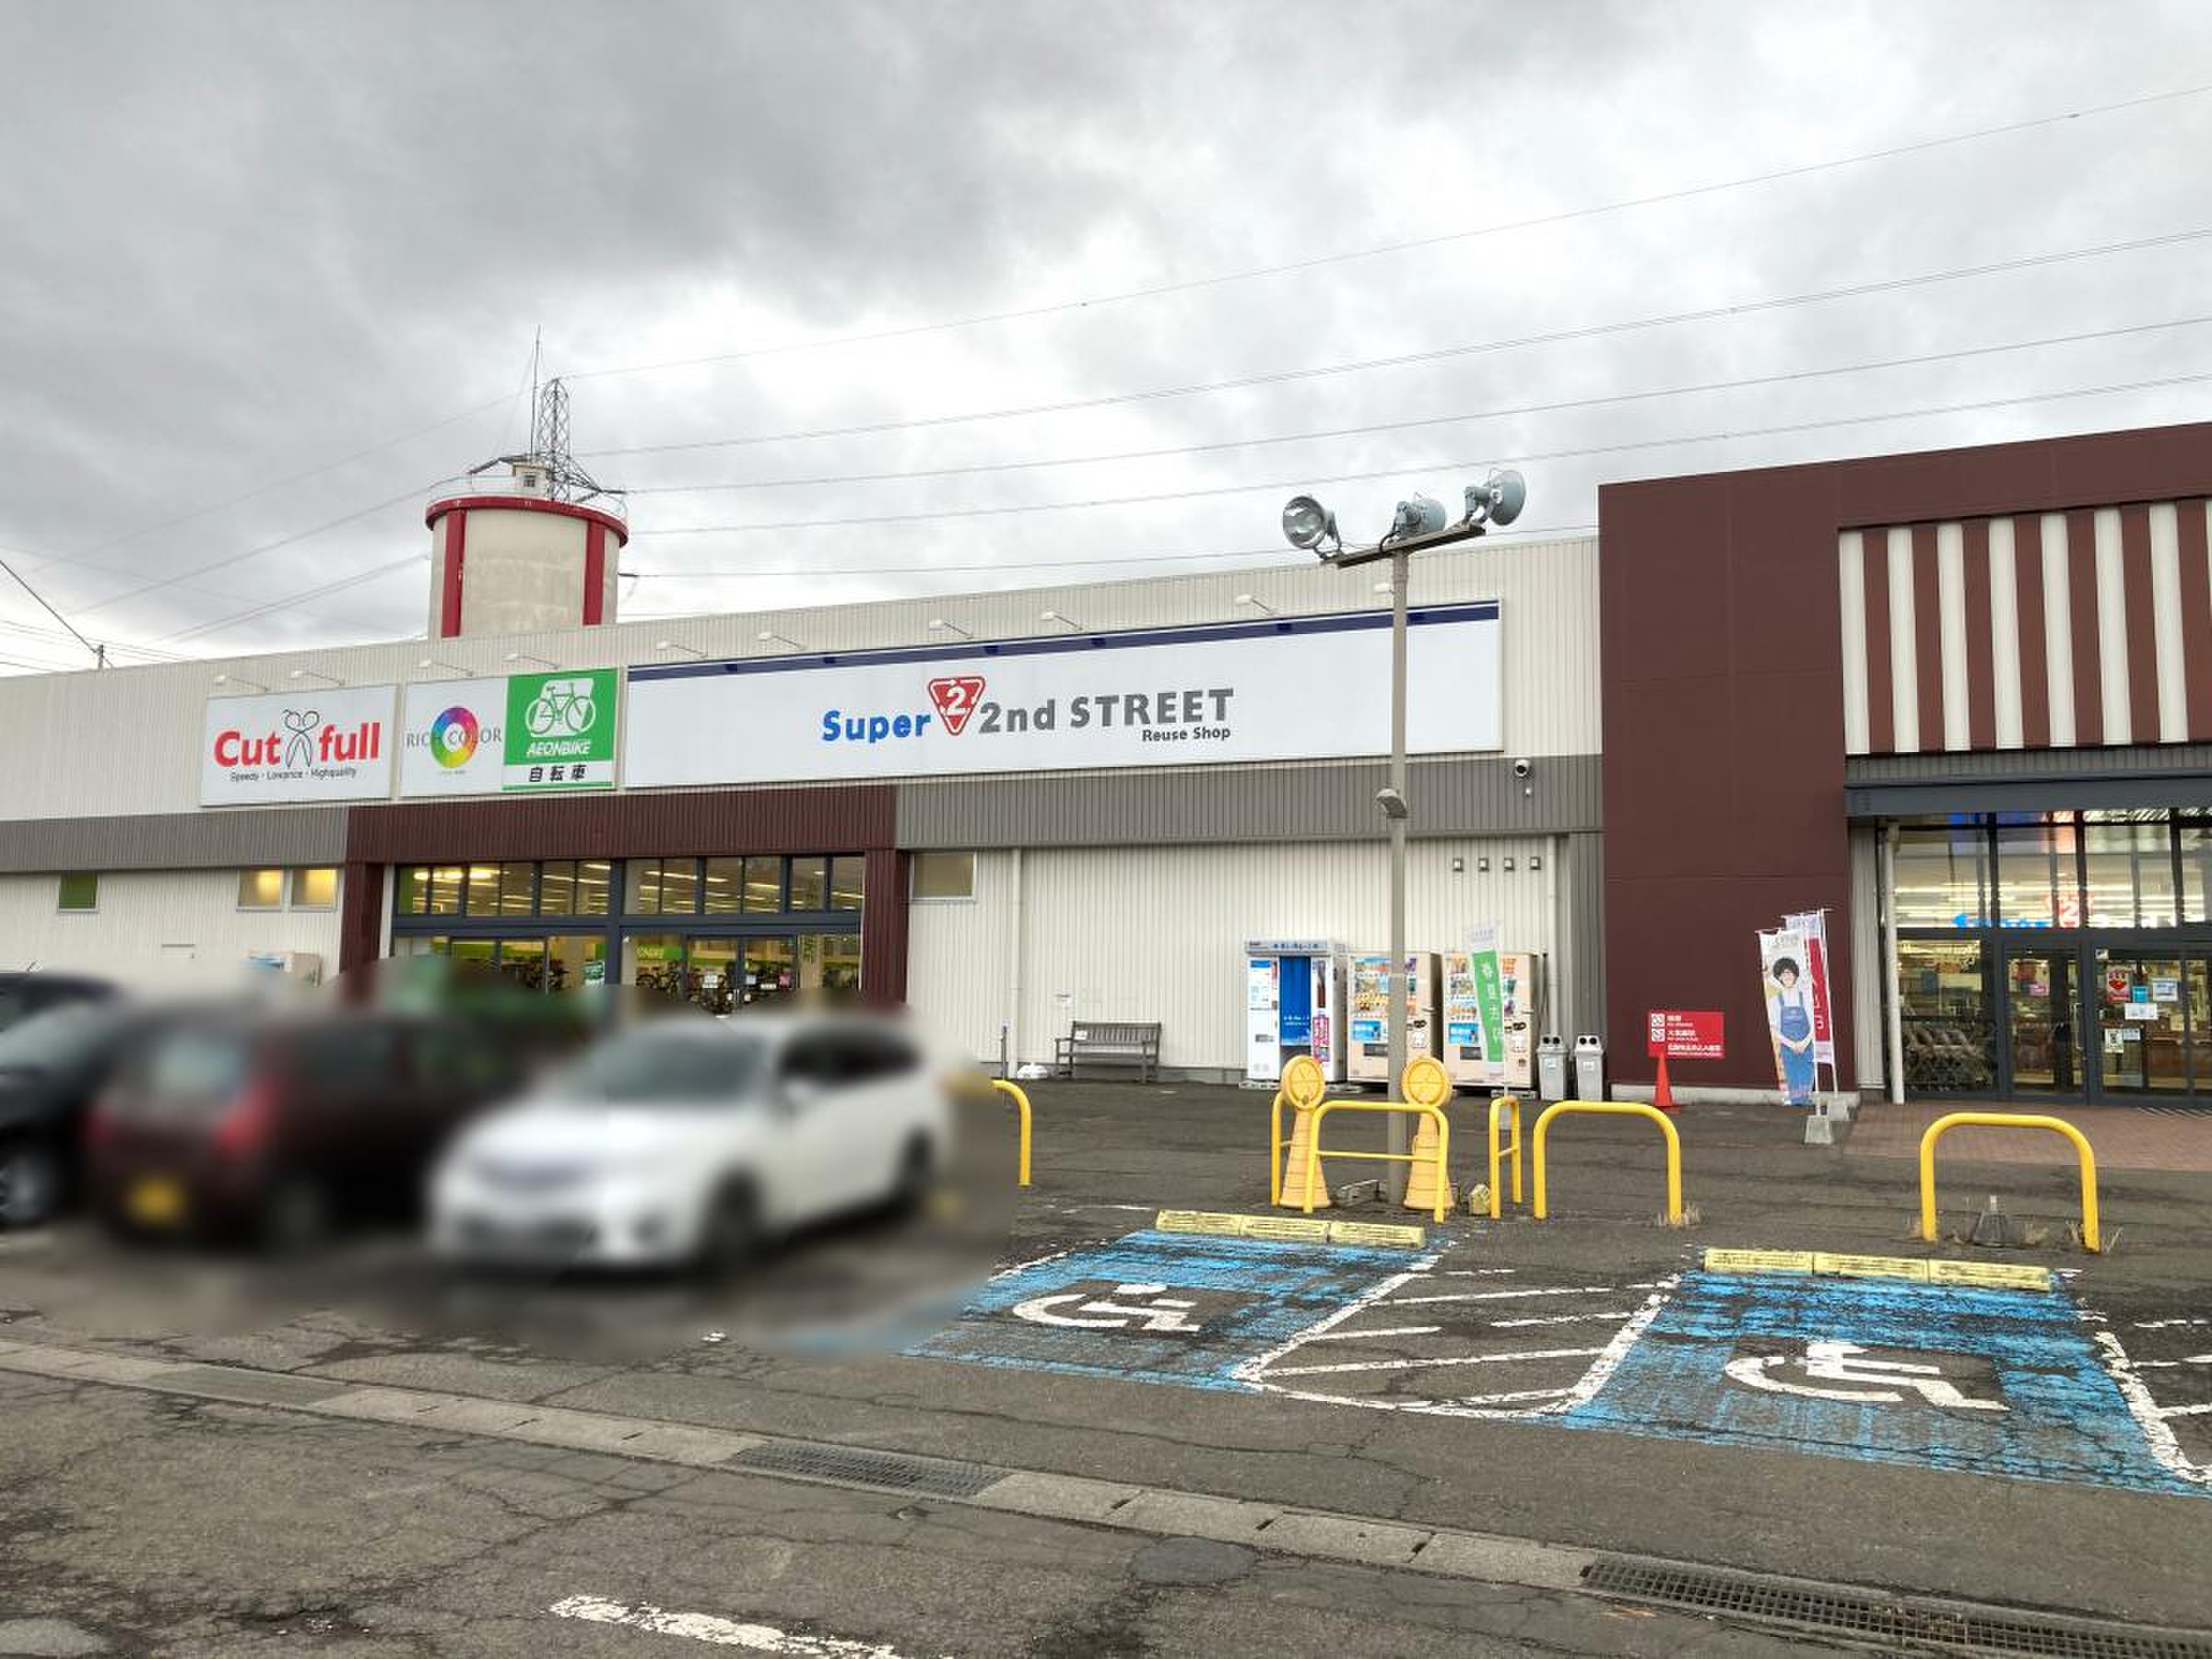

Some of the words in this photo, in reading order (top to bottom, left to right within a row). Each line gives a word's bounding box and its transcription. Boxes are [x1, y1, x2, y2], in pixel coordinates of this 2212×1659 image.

[947, 686, 967, 715] 2
[822, 710, 931, 743] Super
[979, 699, 1055, 735] 2nd
[1070, 688, 1234, 728] STREET
[1142, 728, 1188, 742] Reuse
[1193, 726, 1231, 741] Shop
[214, 730, 281, 767] Cut
[318, 722, 381, 762] full
[526, 739, 592, 758] AEONBIKE
[230, 771, 260, 782] Speedy
[529, 763, 587, 782] 自転車
